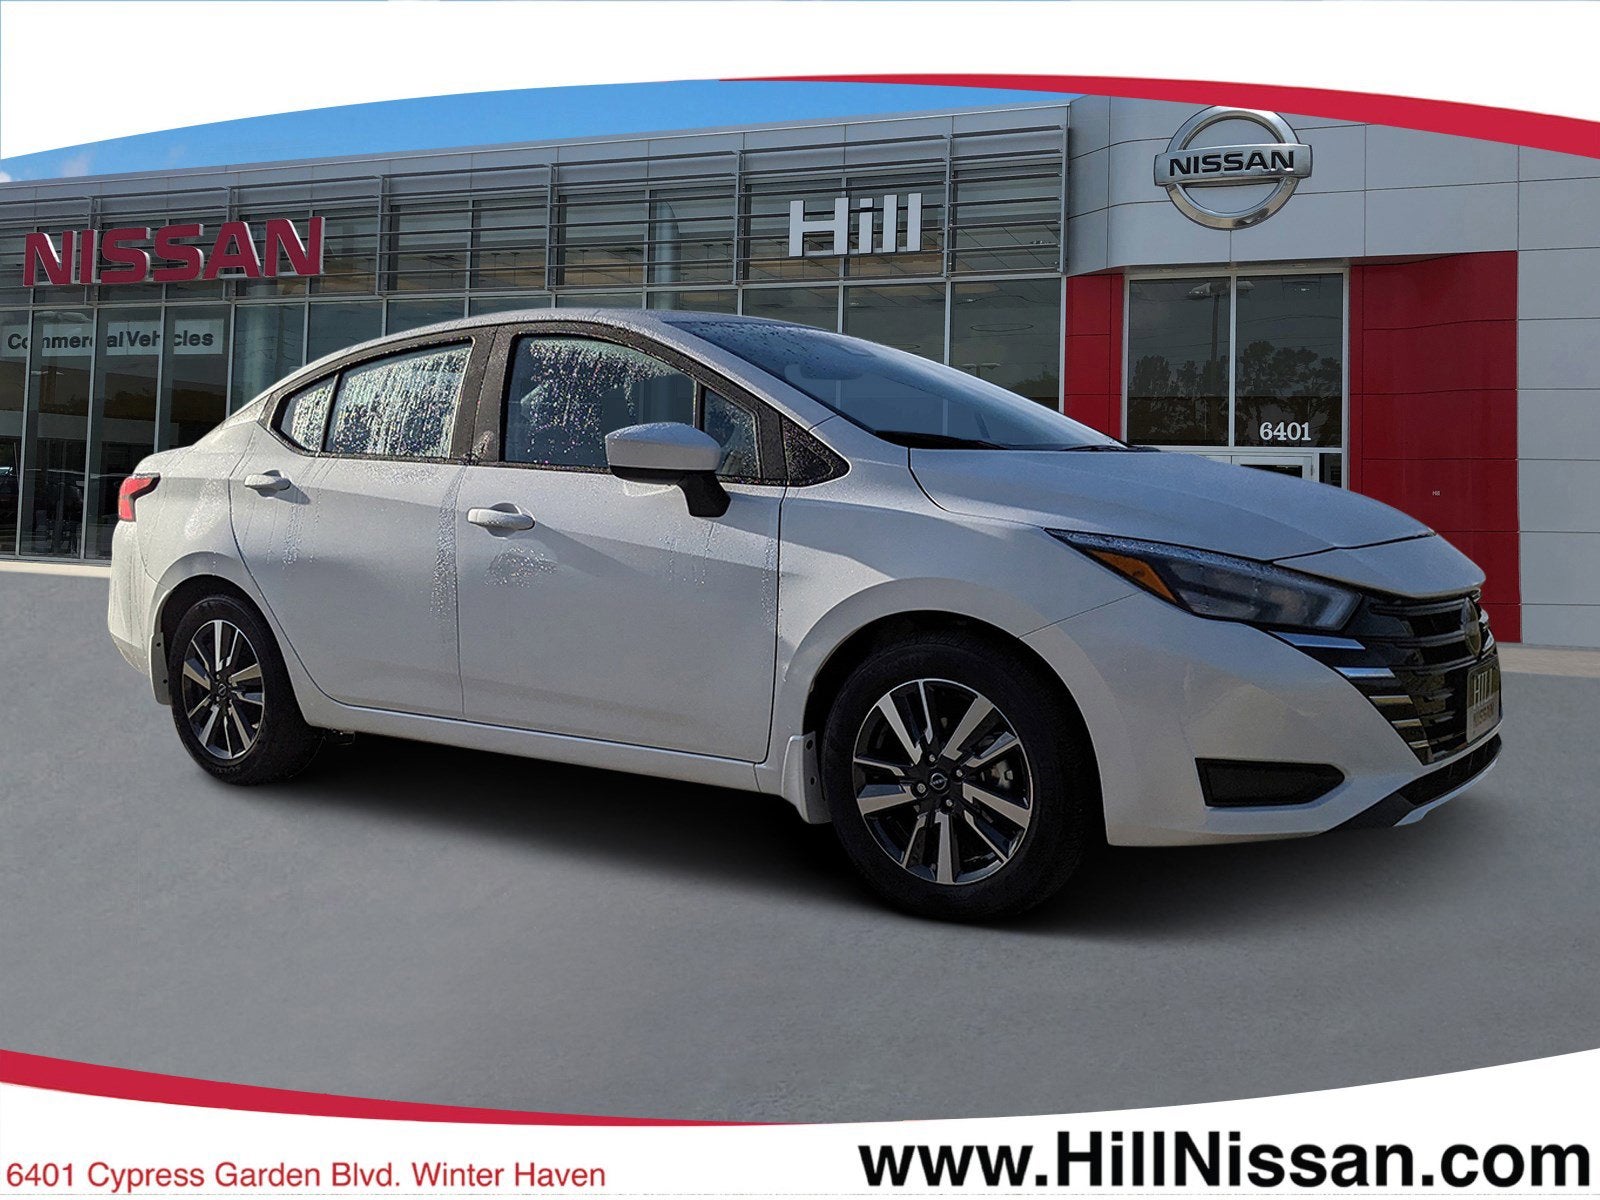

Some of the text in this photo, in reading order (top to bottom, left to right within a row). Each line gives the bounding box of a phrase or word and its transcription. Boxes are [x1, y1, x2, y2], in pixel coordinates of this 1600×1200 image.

[1169, 150, 1294, 176] NISSAN
[788, 193, 923, 258] Hill
[22, 216, 325, 287] NISSAN
[7, 330, 214, 350] Comeral Vehcles
[1259, 421, 1312, 441] 6401
